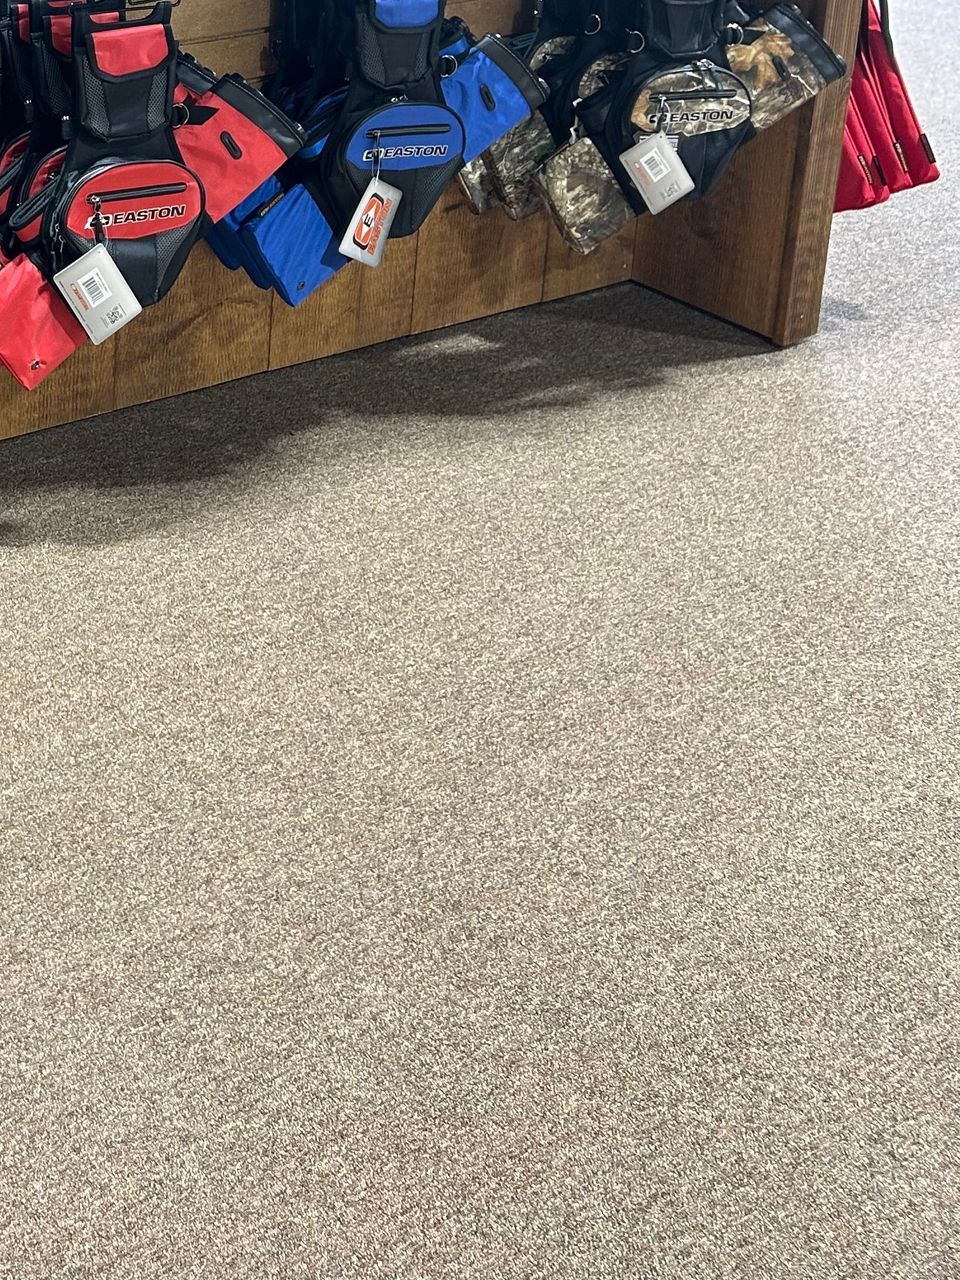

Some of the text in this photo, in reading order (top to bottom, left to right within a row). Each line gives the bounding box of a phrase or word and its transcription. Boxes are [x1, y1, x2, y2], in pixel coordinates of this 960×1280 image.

[669, 110, 734, 123] EASTON
[385, 145, 449, 158] EASTON
[113, 205, 186, 225] EASTON
[367, 198, 392, 255] EASTON
